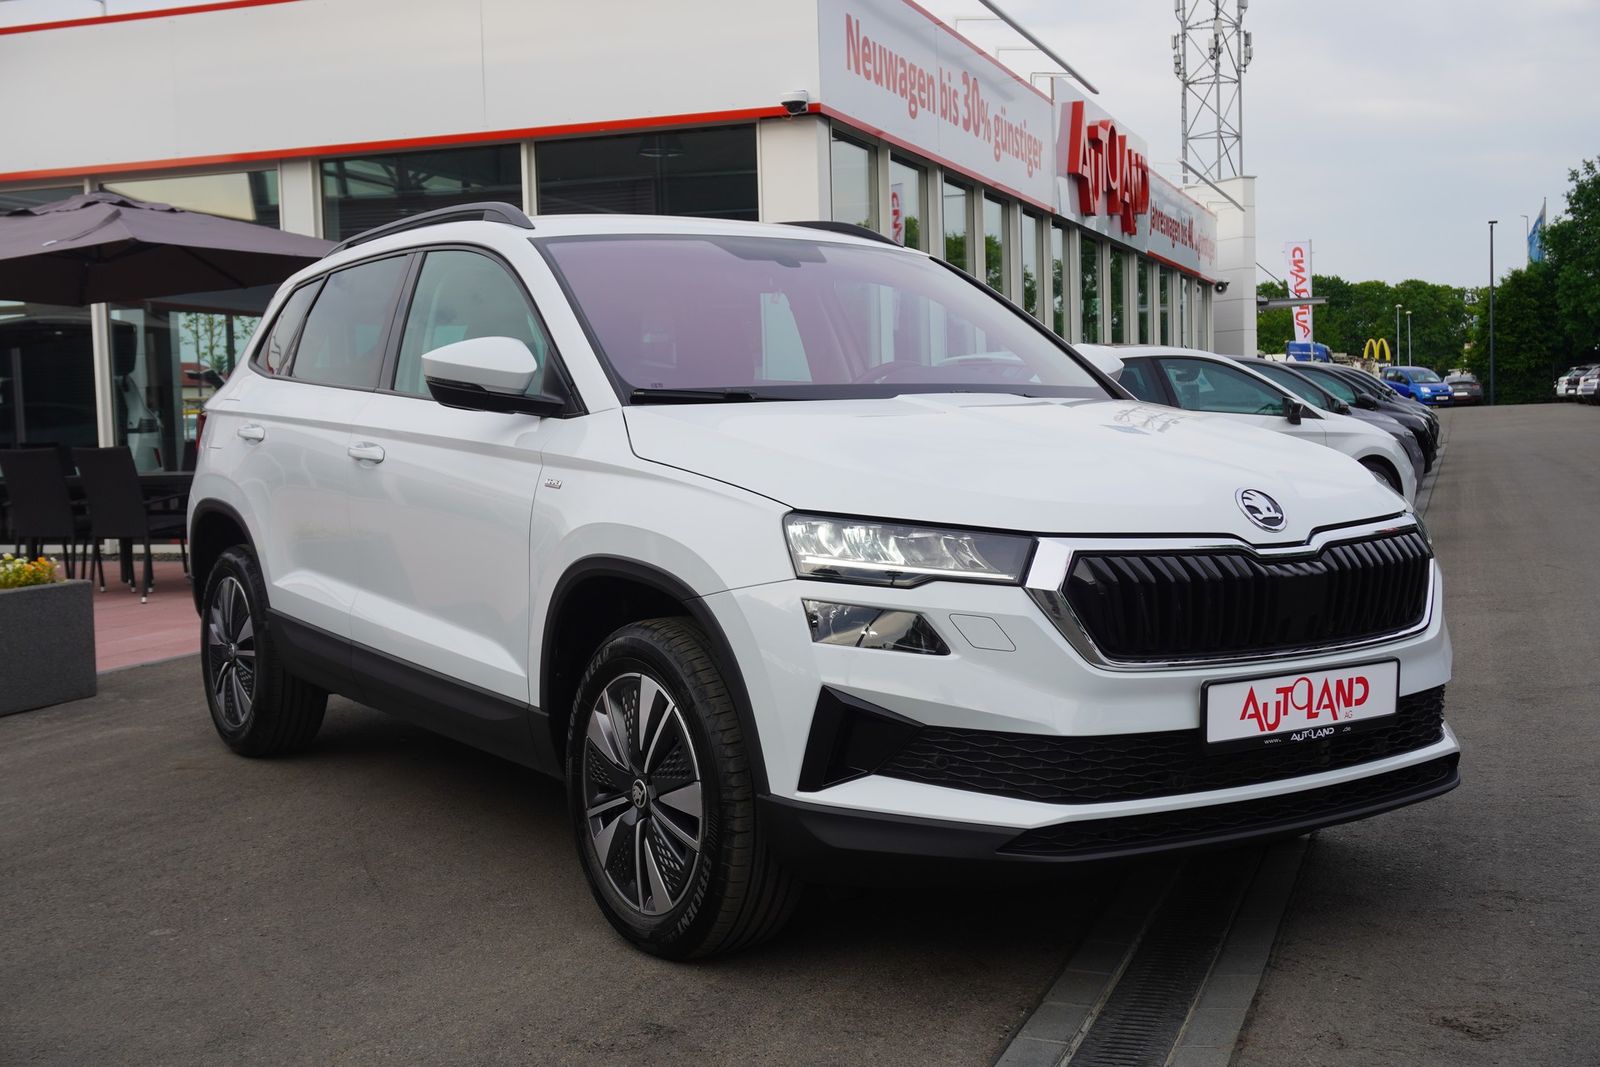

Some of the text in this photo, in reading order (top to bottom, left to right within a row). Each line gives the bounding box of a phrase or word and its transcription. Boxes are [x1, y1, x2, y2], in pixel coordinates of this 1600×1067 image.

[845, 13, 1043, 178] Neuwagen bis 30% günstiger
[1067, 100, 1150, 236] AUTOLAND
[1239, 676, 1370, 732] AUTOLAND
[1343, 711, 1353, 719] AG
[1290, 727, 1335, 741] AUTOLAND
